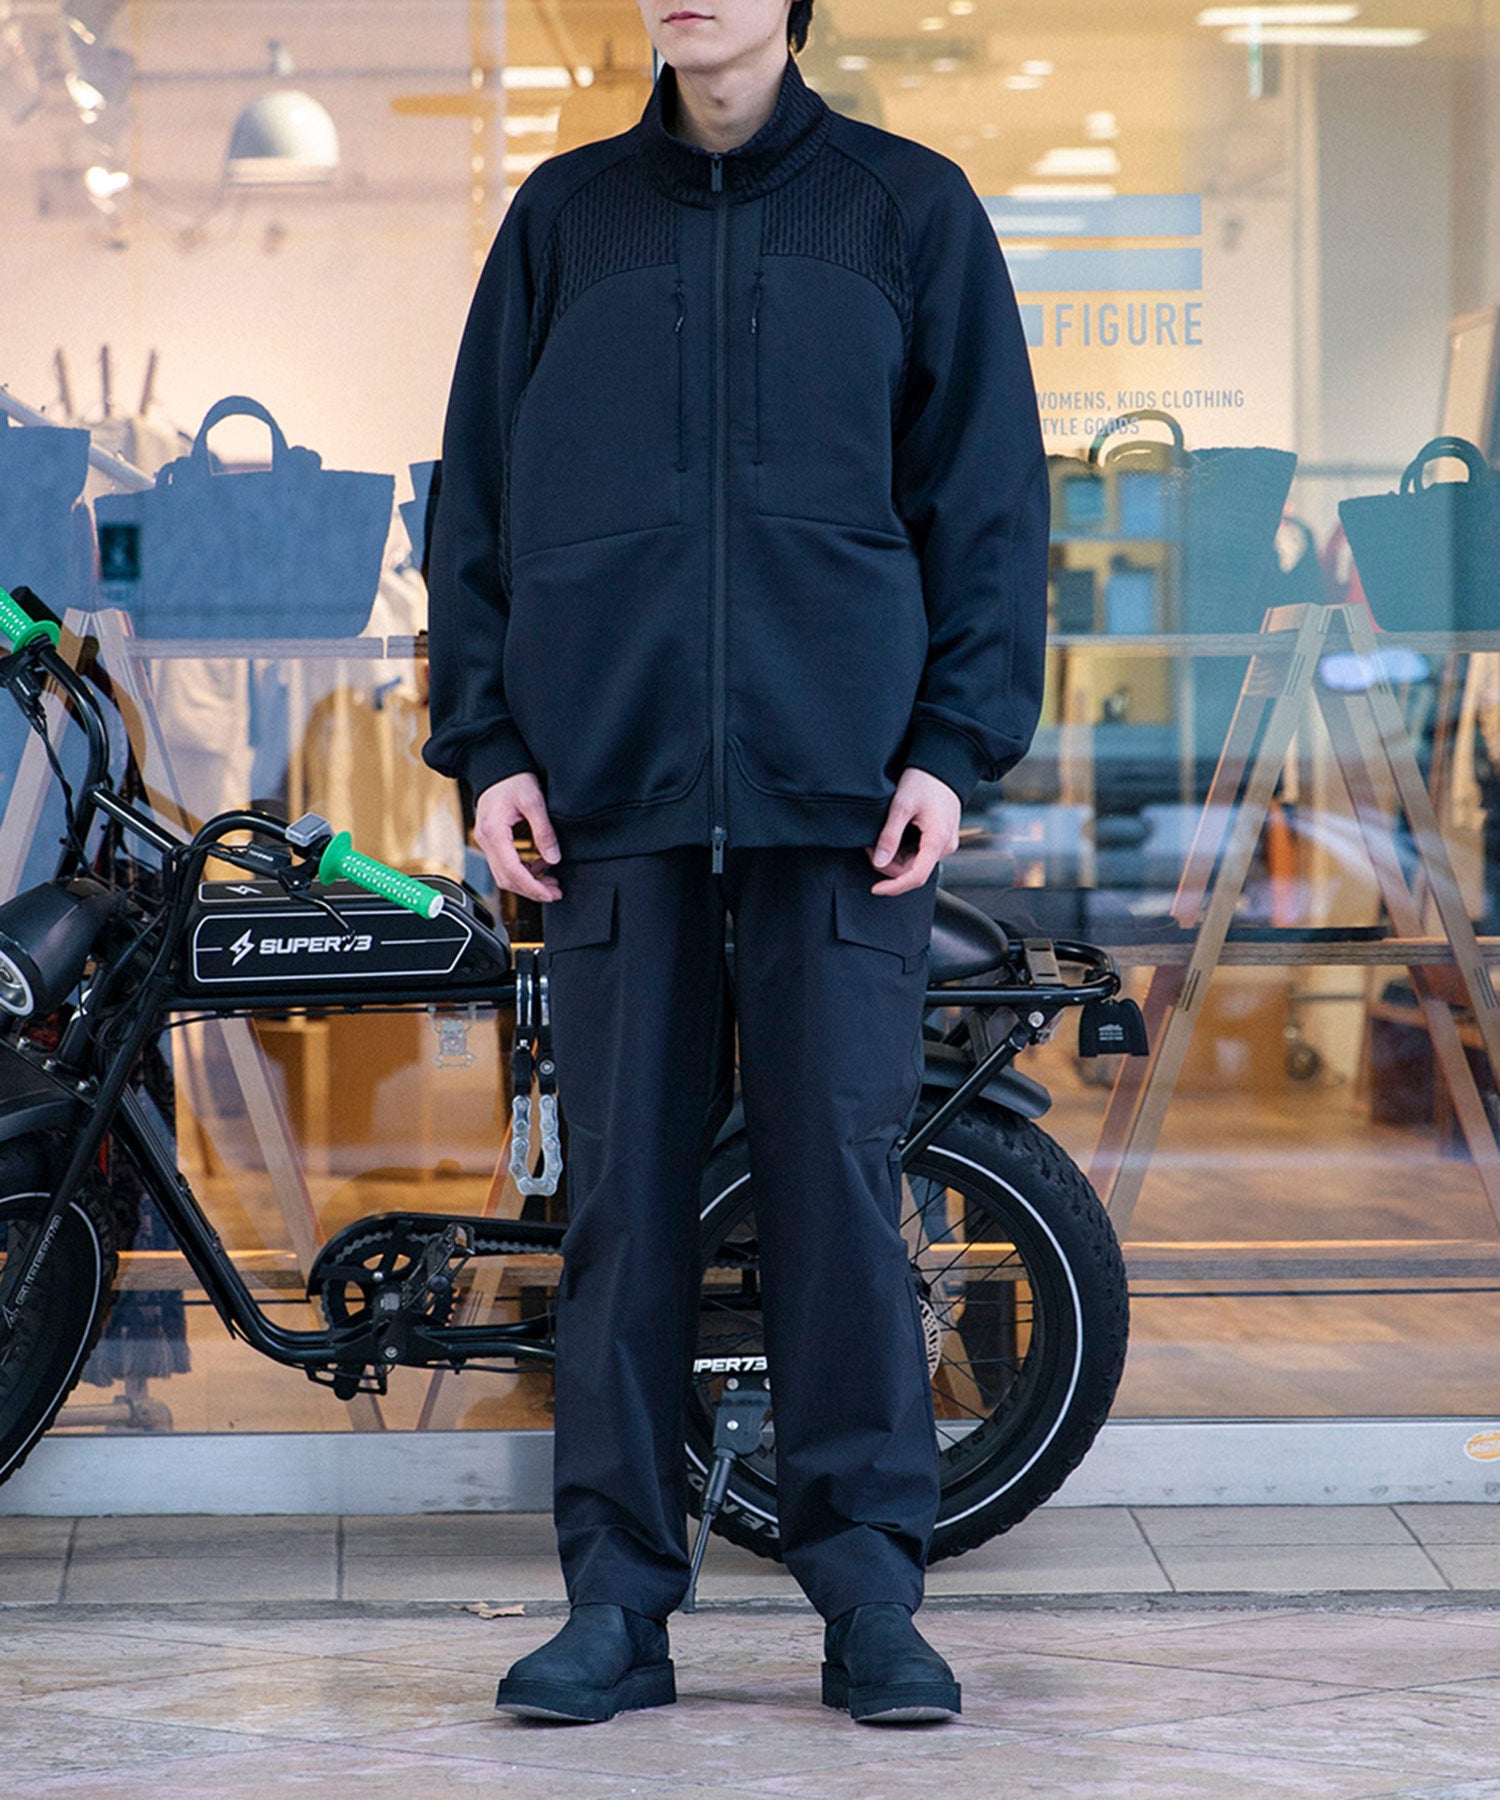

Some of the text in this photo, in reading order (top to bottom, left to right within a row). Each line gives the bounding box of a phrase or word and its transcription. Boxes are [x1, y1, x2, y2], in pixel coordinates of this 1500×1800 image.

[1055, 302, 1203, 347] FIGURE
[1117, 390, 1156, 410] KIDS
[1162, 388, 1244, 409] CLOTHING
[1041, 416, 1140, 437] TYLE GOODS
[259, 934, 373, 955] SUPER73
[687, 1463, 780, 1539] KEND
